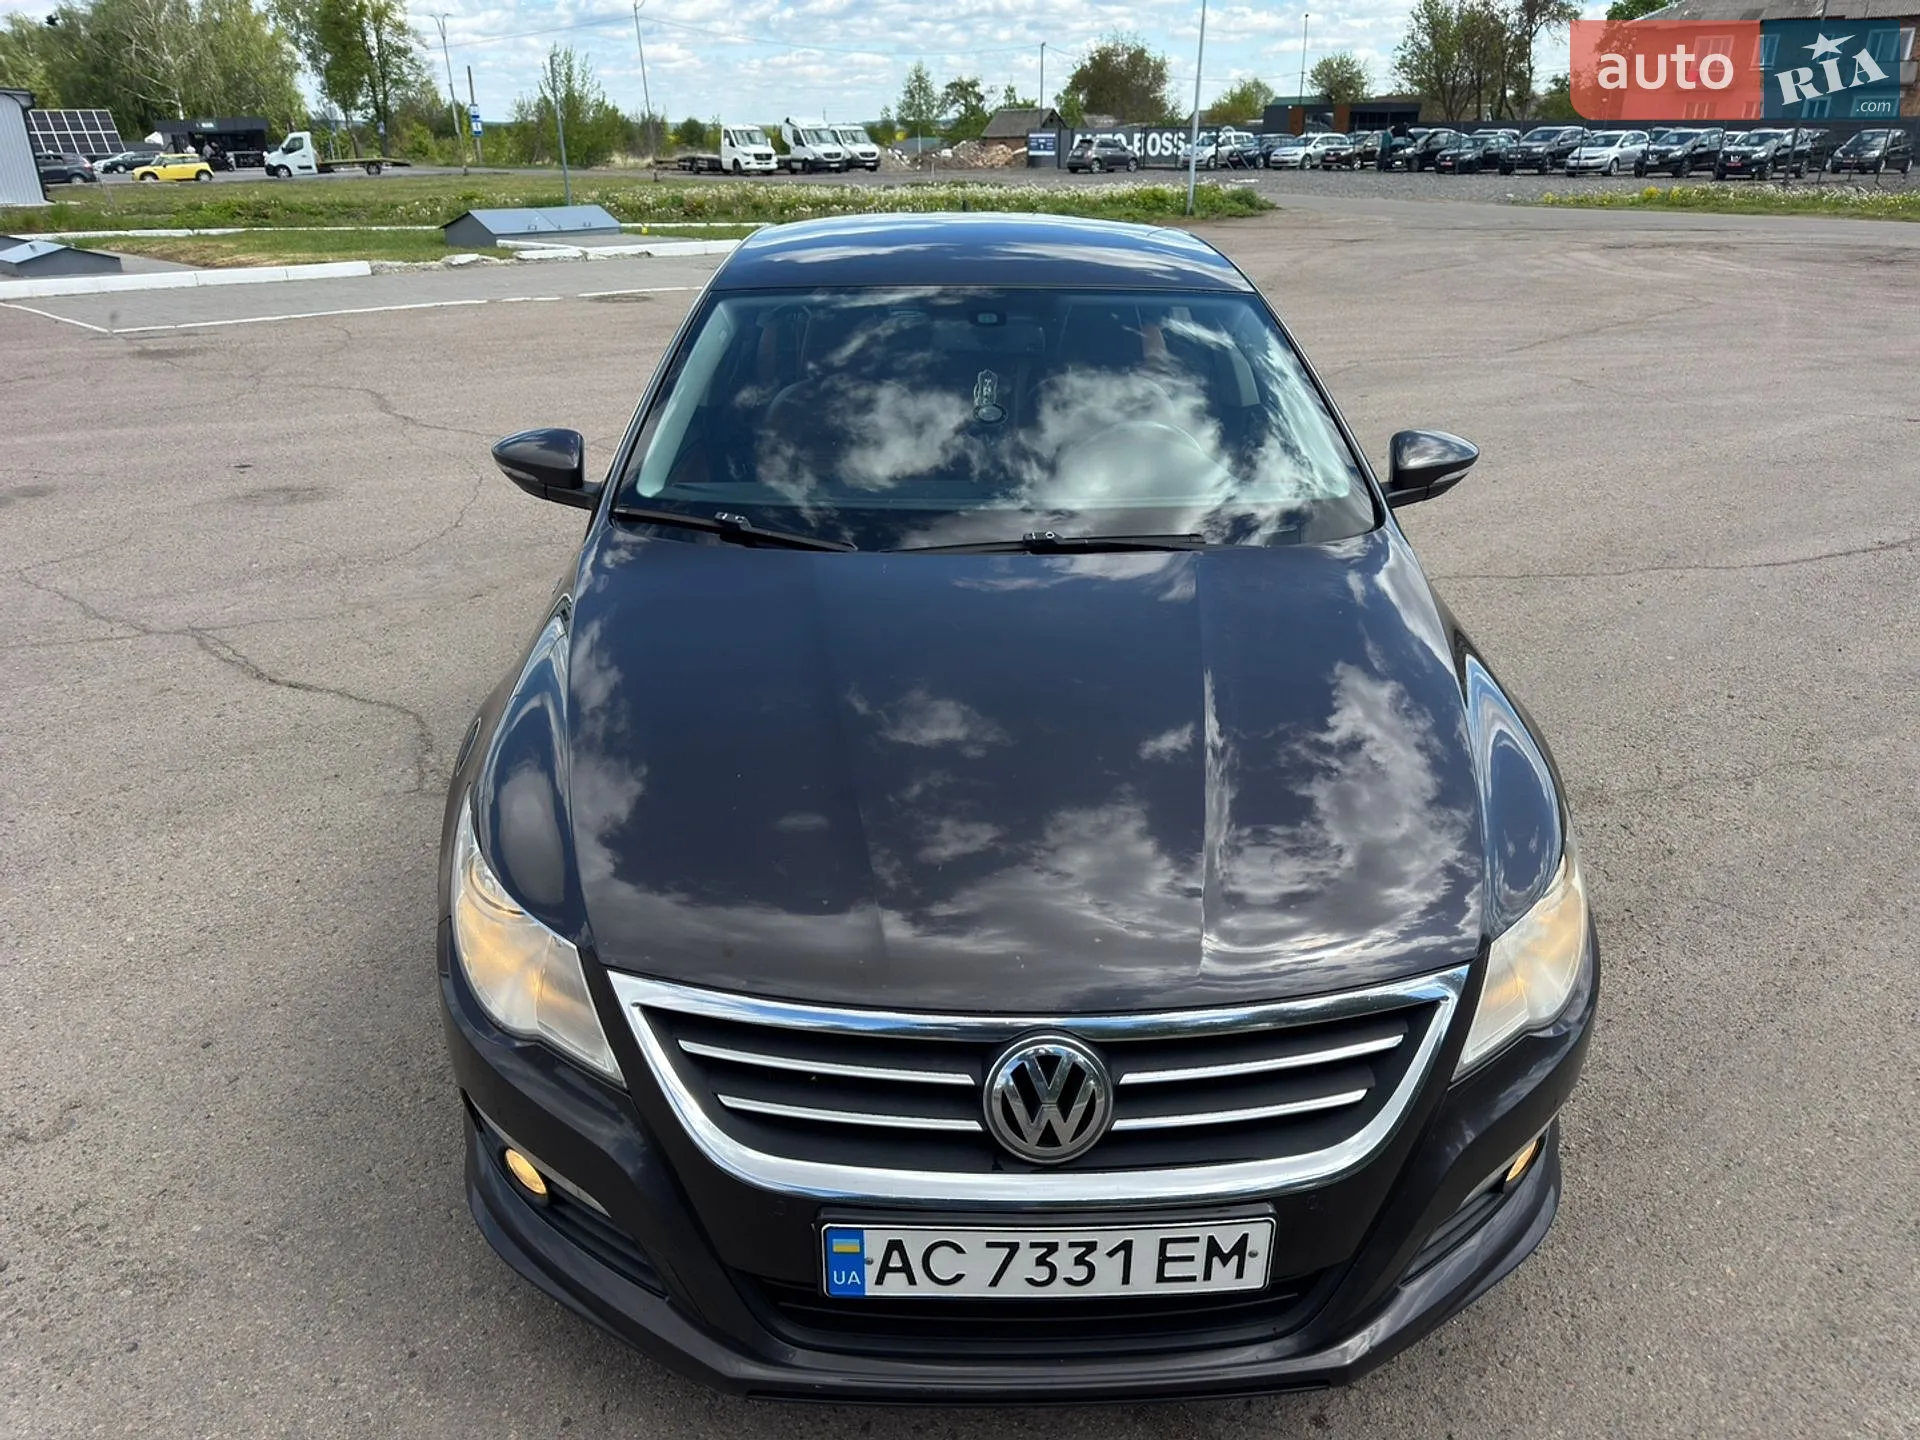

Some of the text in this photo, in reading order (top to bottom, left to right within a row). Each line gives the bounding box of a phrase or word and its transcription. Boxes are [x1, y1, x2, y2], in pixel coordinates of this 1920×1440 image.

[992, 1044, 1105, 1157] VW
[833, 1232, 1249, 1288] UA AC 7331 EM
